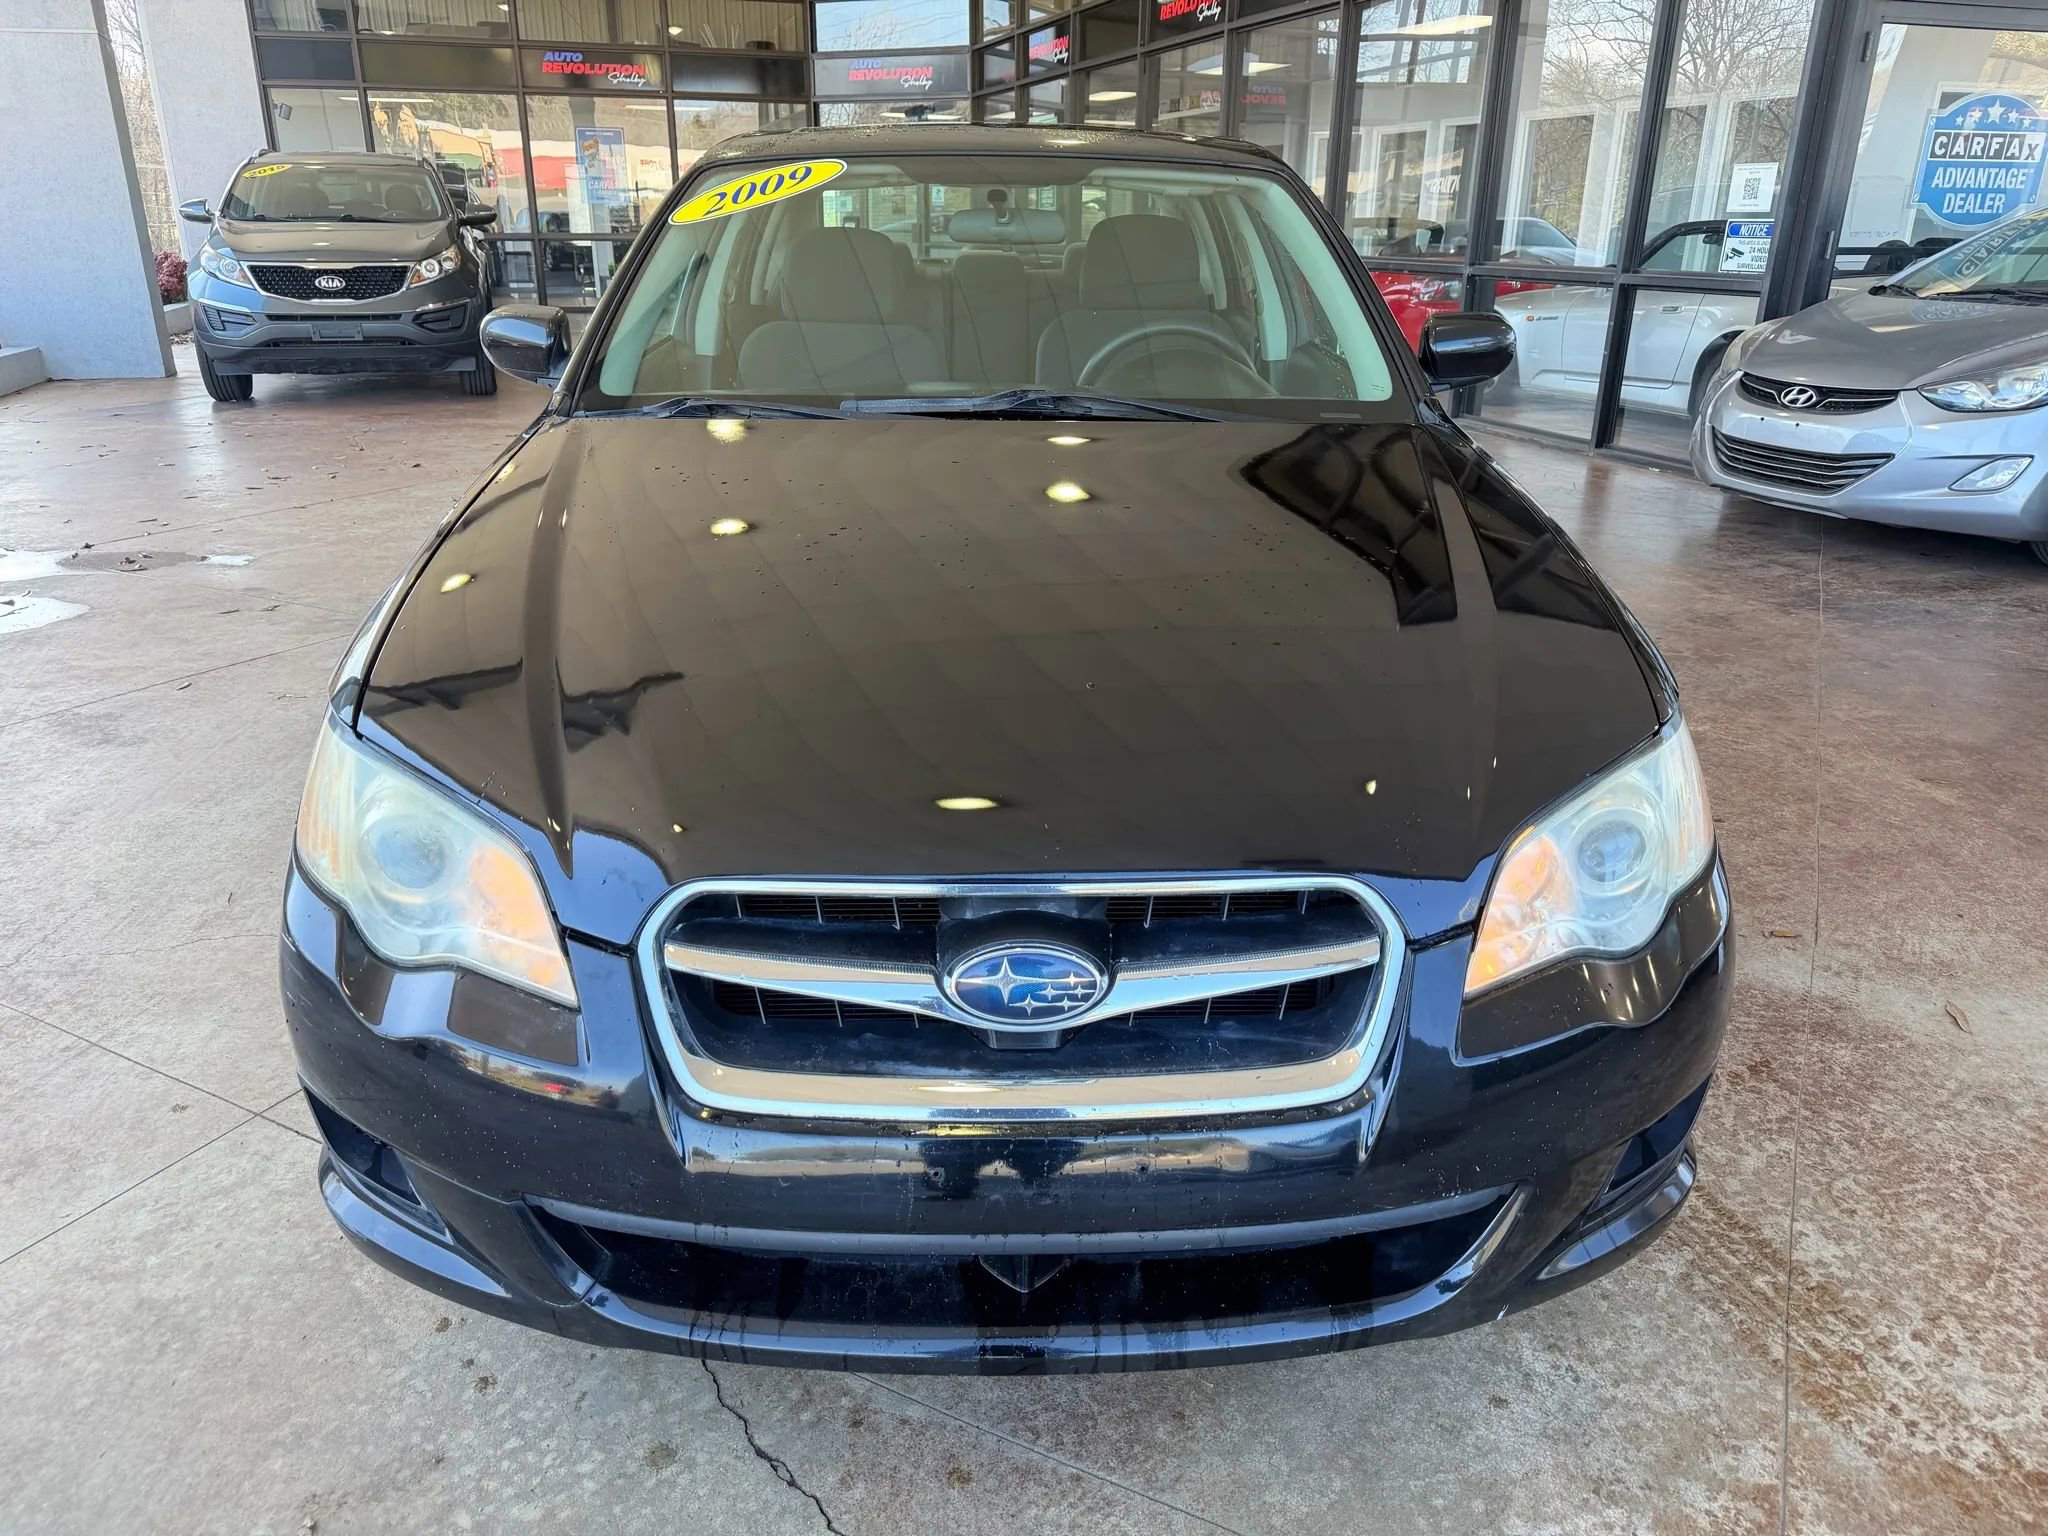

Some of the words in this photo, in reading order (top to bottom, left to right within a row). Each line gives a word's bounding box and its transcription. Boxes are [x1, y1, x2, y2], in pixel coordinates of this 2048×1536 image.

[1160, 0, 1222, 20] REVOLU
[543, 51, 582, 61] AUTO
[543, 62, 646, 75] REVOLUTION
[850, 60, 881, 69] AUTO
[608, 72, 646, 87] Shelby
[848, 66, 933, 80] REVOLUTION
[900, 75, 933, 90] Shelby
[1934, 134, 2041, 161] CARFAX
[1931, 167, 2028, 189] ADVANTAGE
[701, 165, 814, 218] 2009
[1942, 192, 2006, 214] DEALER
[1739, 224, 1769, 236] NOTICE
[1748, 246, 1756, 254] 24
[1751, 255, 1767, 263] VIDEO
[319, 278, 342, 288] KIA
